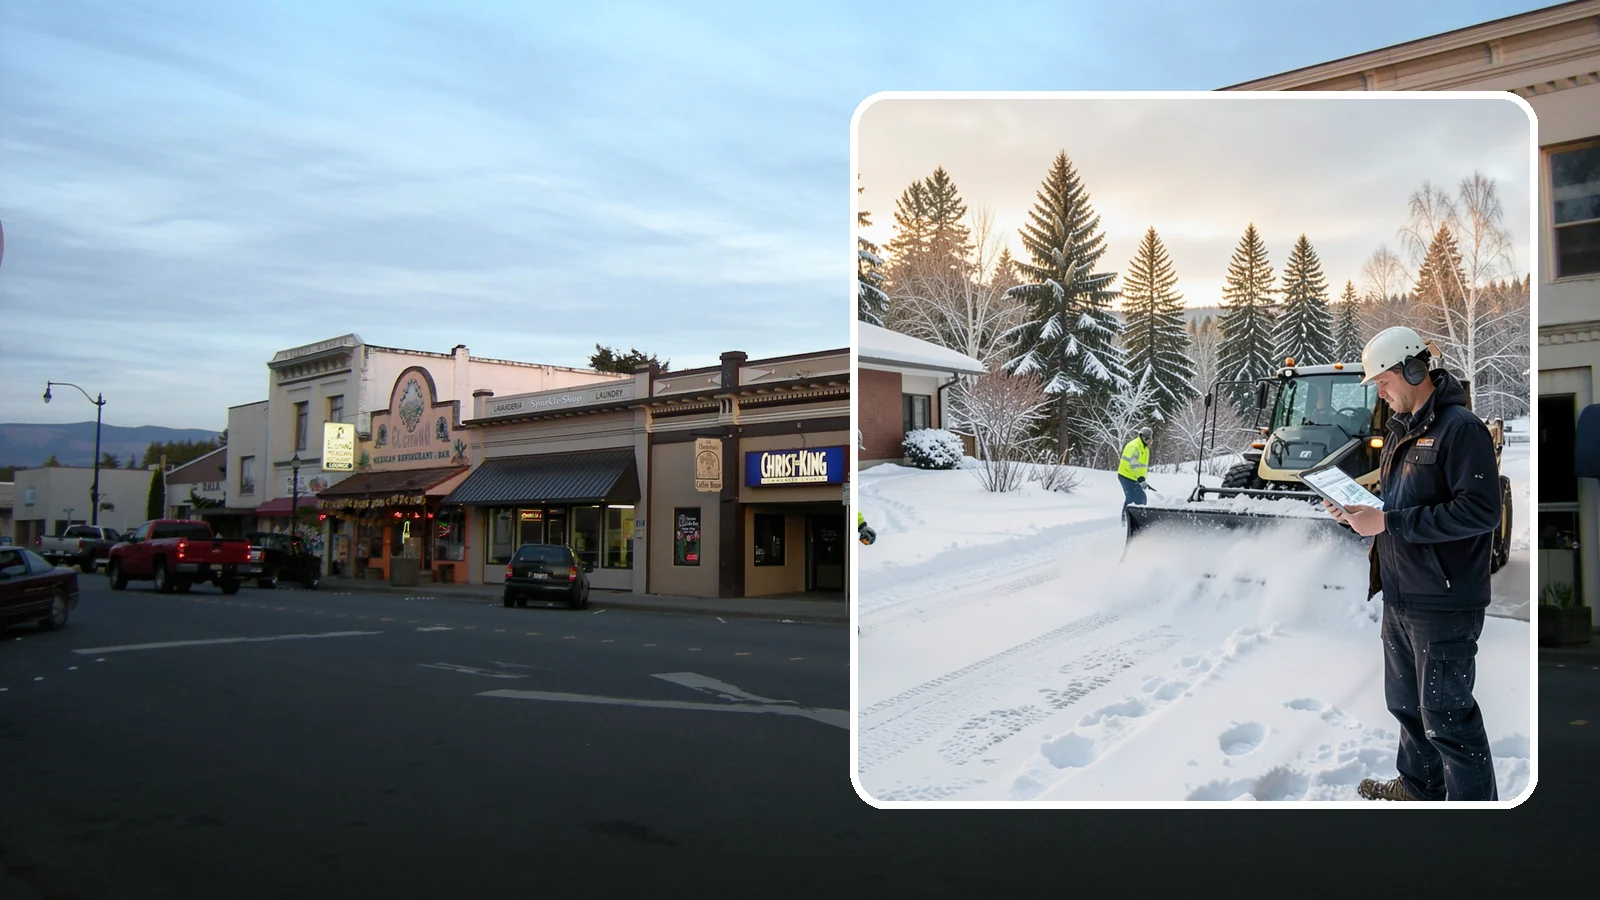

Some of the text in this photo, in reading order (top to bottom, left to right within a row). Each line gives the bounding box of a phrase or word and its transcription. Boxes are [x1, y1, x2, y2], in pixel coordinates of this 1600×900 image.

[562, 394, 582, 405] Shop
[595, 389, 623, 400] LAUNDRY
[493, 402, 522, 413] LAVANDERIA
[373, 454, 396, 464] MEXICAN
[397, 451, 433, 461] RESTAURANT
[438, 450, 450, 459] BAR
[761, 450, 827, 478] CHRIST KING
